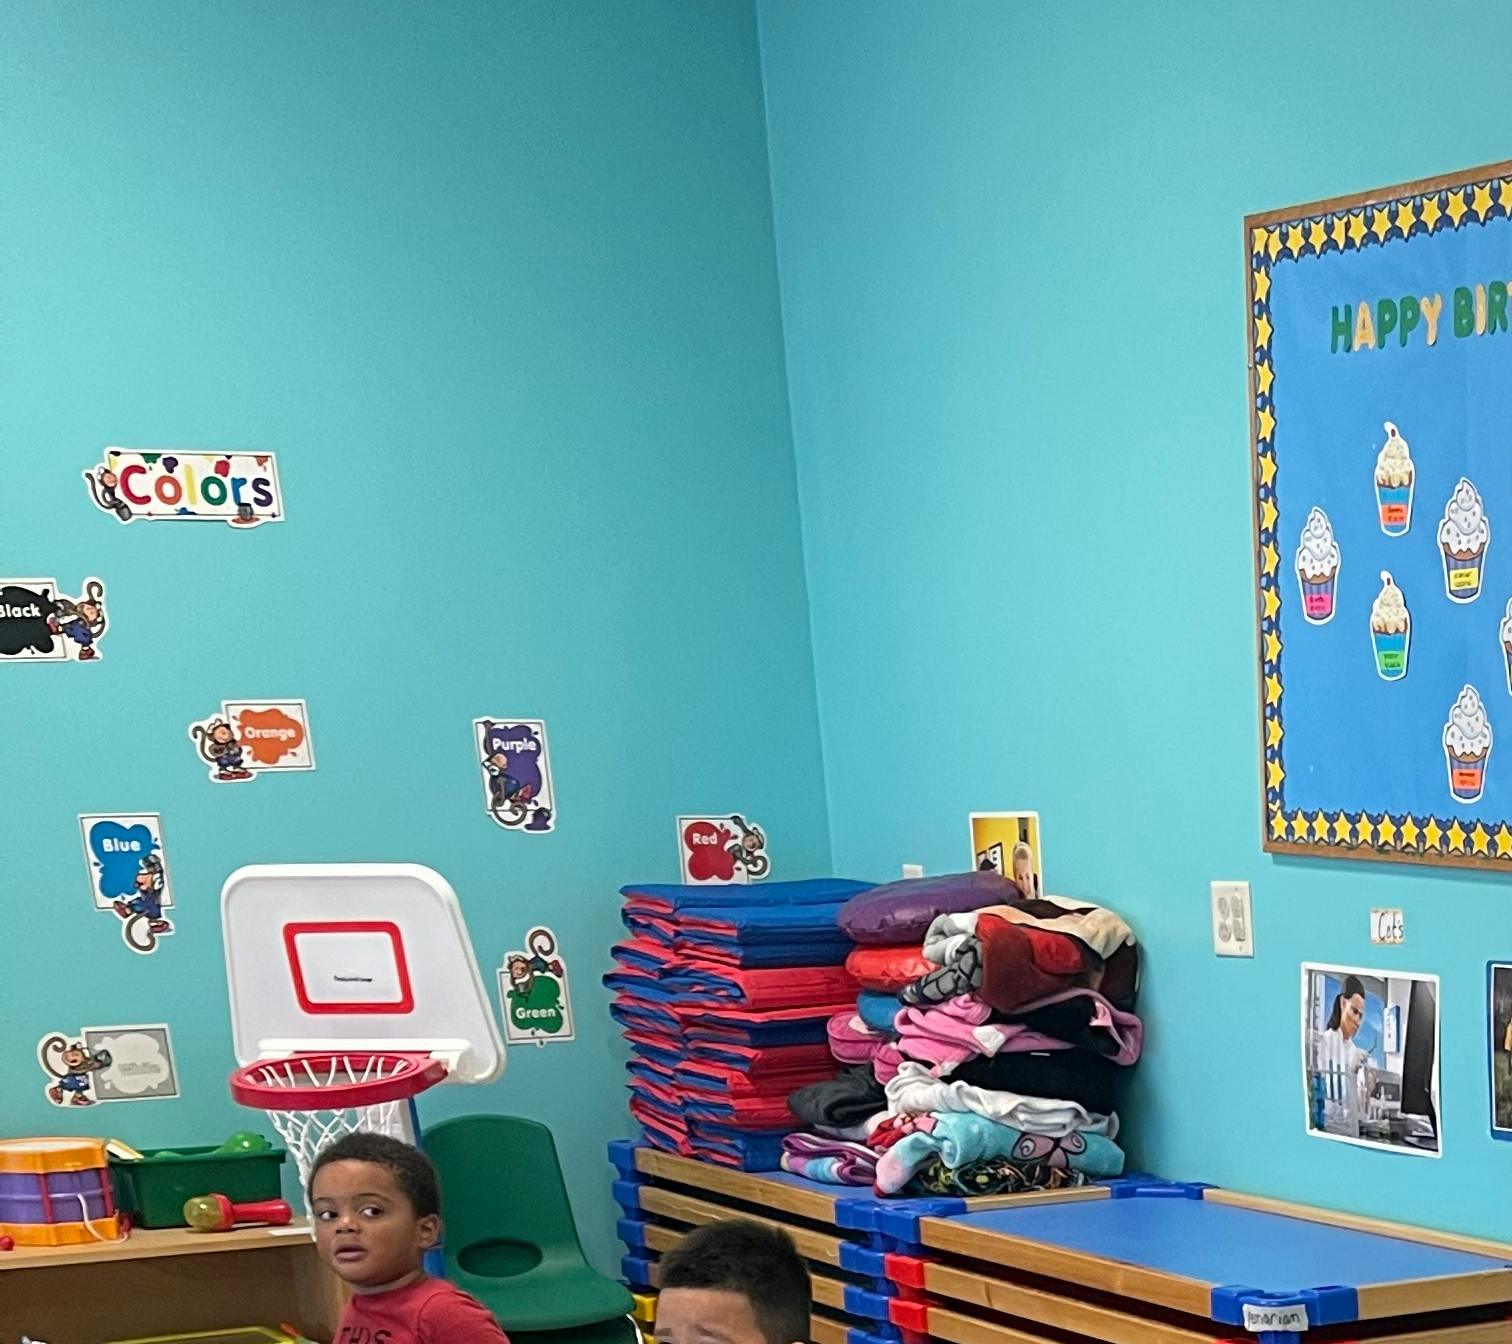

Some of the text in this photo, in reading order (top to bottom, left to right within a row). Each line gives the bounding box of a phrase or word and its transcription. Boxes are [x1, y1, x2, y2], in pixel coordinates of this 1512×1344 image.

[1330, 293, 1442, 353] HAPPY
[119, 464, 274, 508] Colors
[243, 725, 297, 742] Orange
[491, 737, 538, 754] Purple
[102, 837, 142, 854] Blue
[691, 831, 719, 847] Red
[515, 1005, 557, 1020] Green
